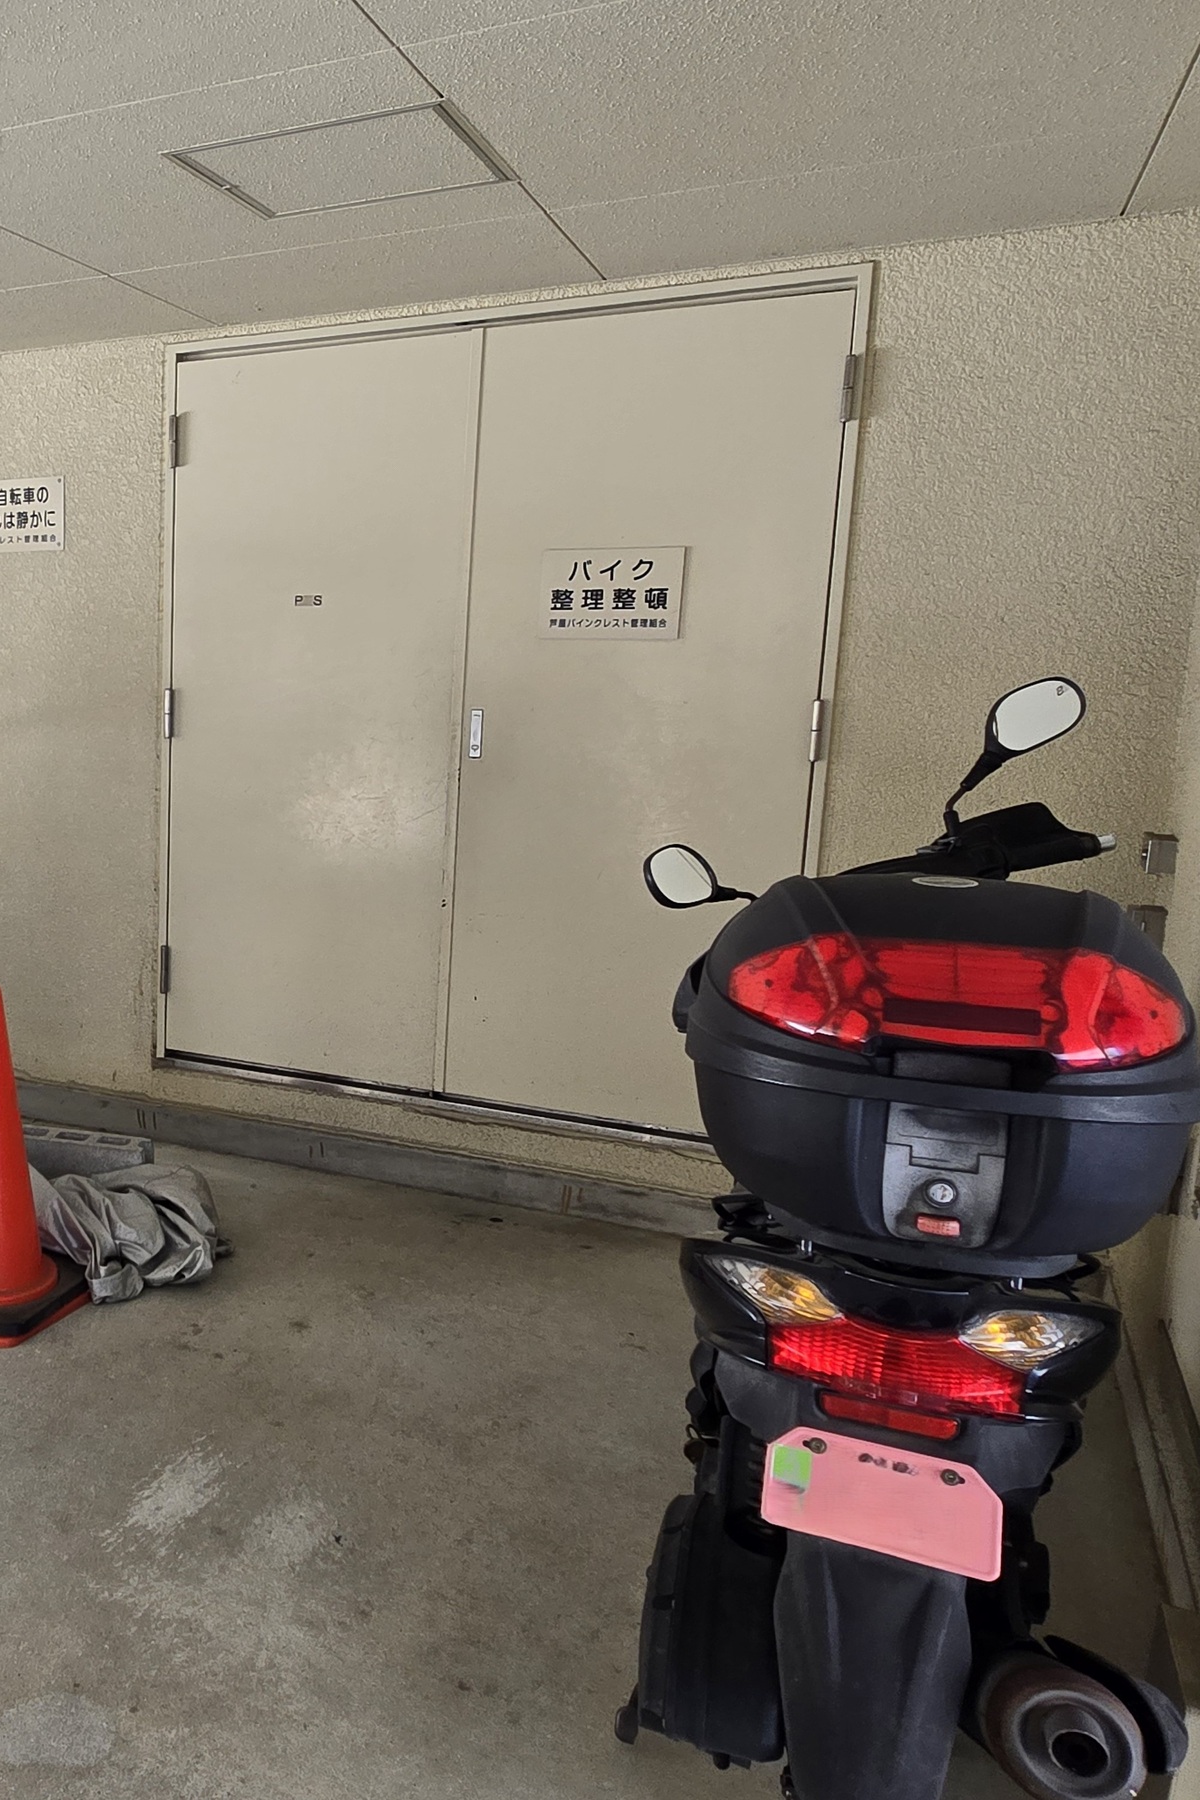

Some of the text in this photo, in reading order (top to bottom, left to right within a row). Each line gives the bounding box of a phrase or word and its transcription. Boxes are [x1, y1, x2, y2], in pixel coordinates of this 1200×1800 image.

[568, 558, 654, 581] バイク
[549, 587, 669, 611] 整理整頓
